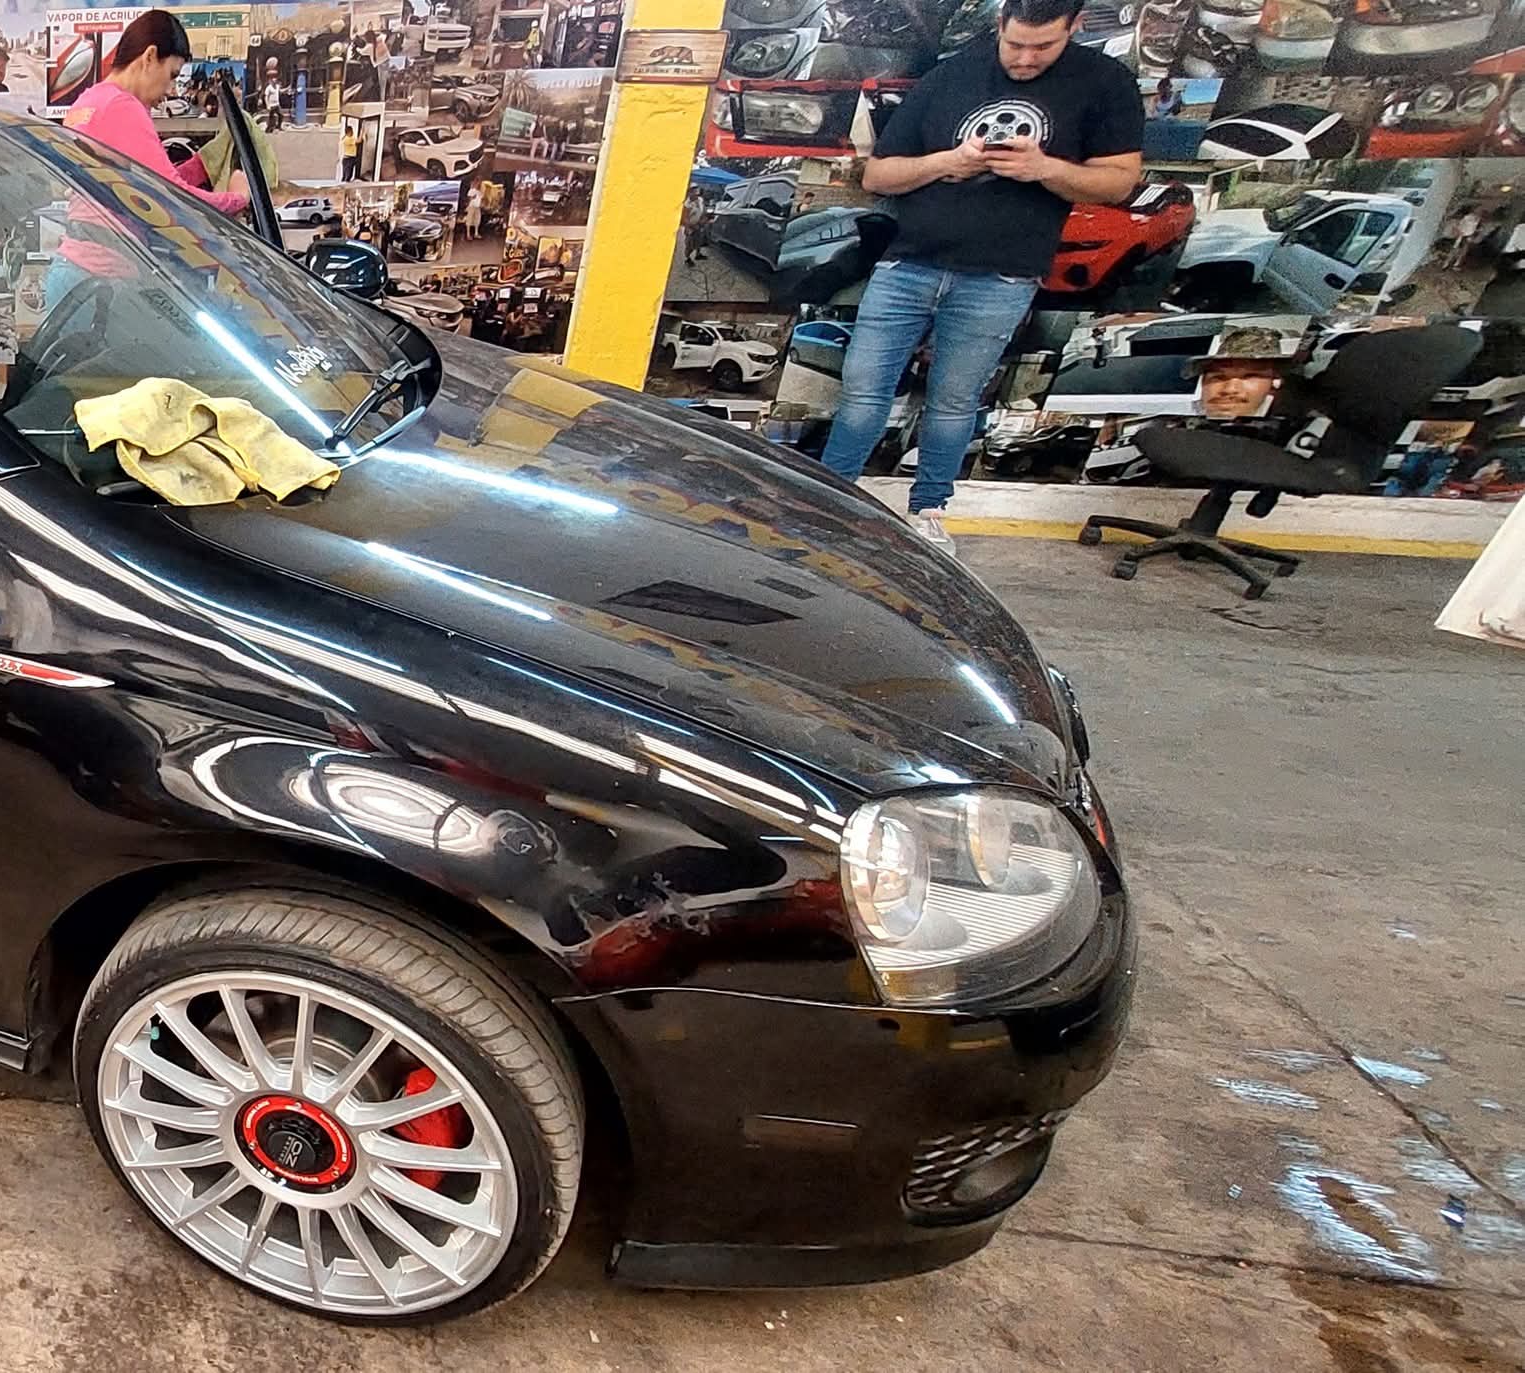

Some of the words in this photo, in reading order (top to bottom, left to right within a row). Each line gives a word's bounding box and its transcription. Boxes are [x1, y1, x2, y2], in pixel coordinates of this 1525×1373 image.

[47, 13, 82, 22] VAPOR
[86, 12, 99, 21] DE
[102, 11, 142, 20] ACRILIC
